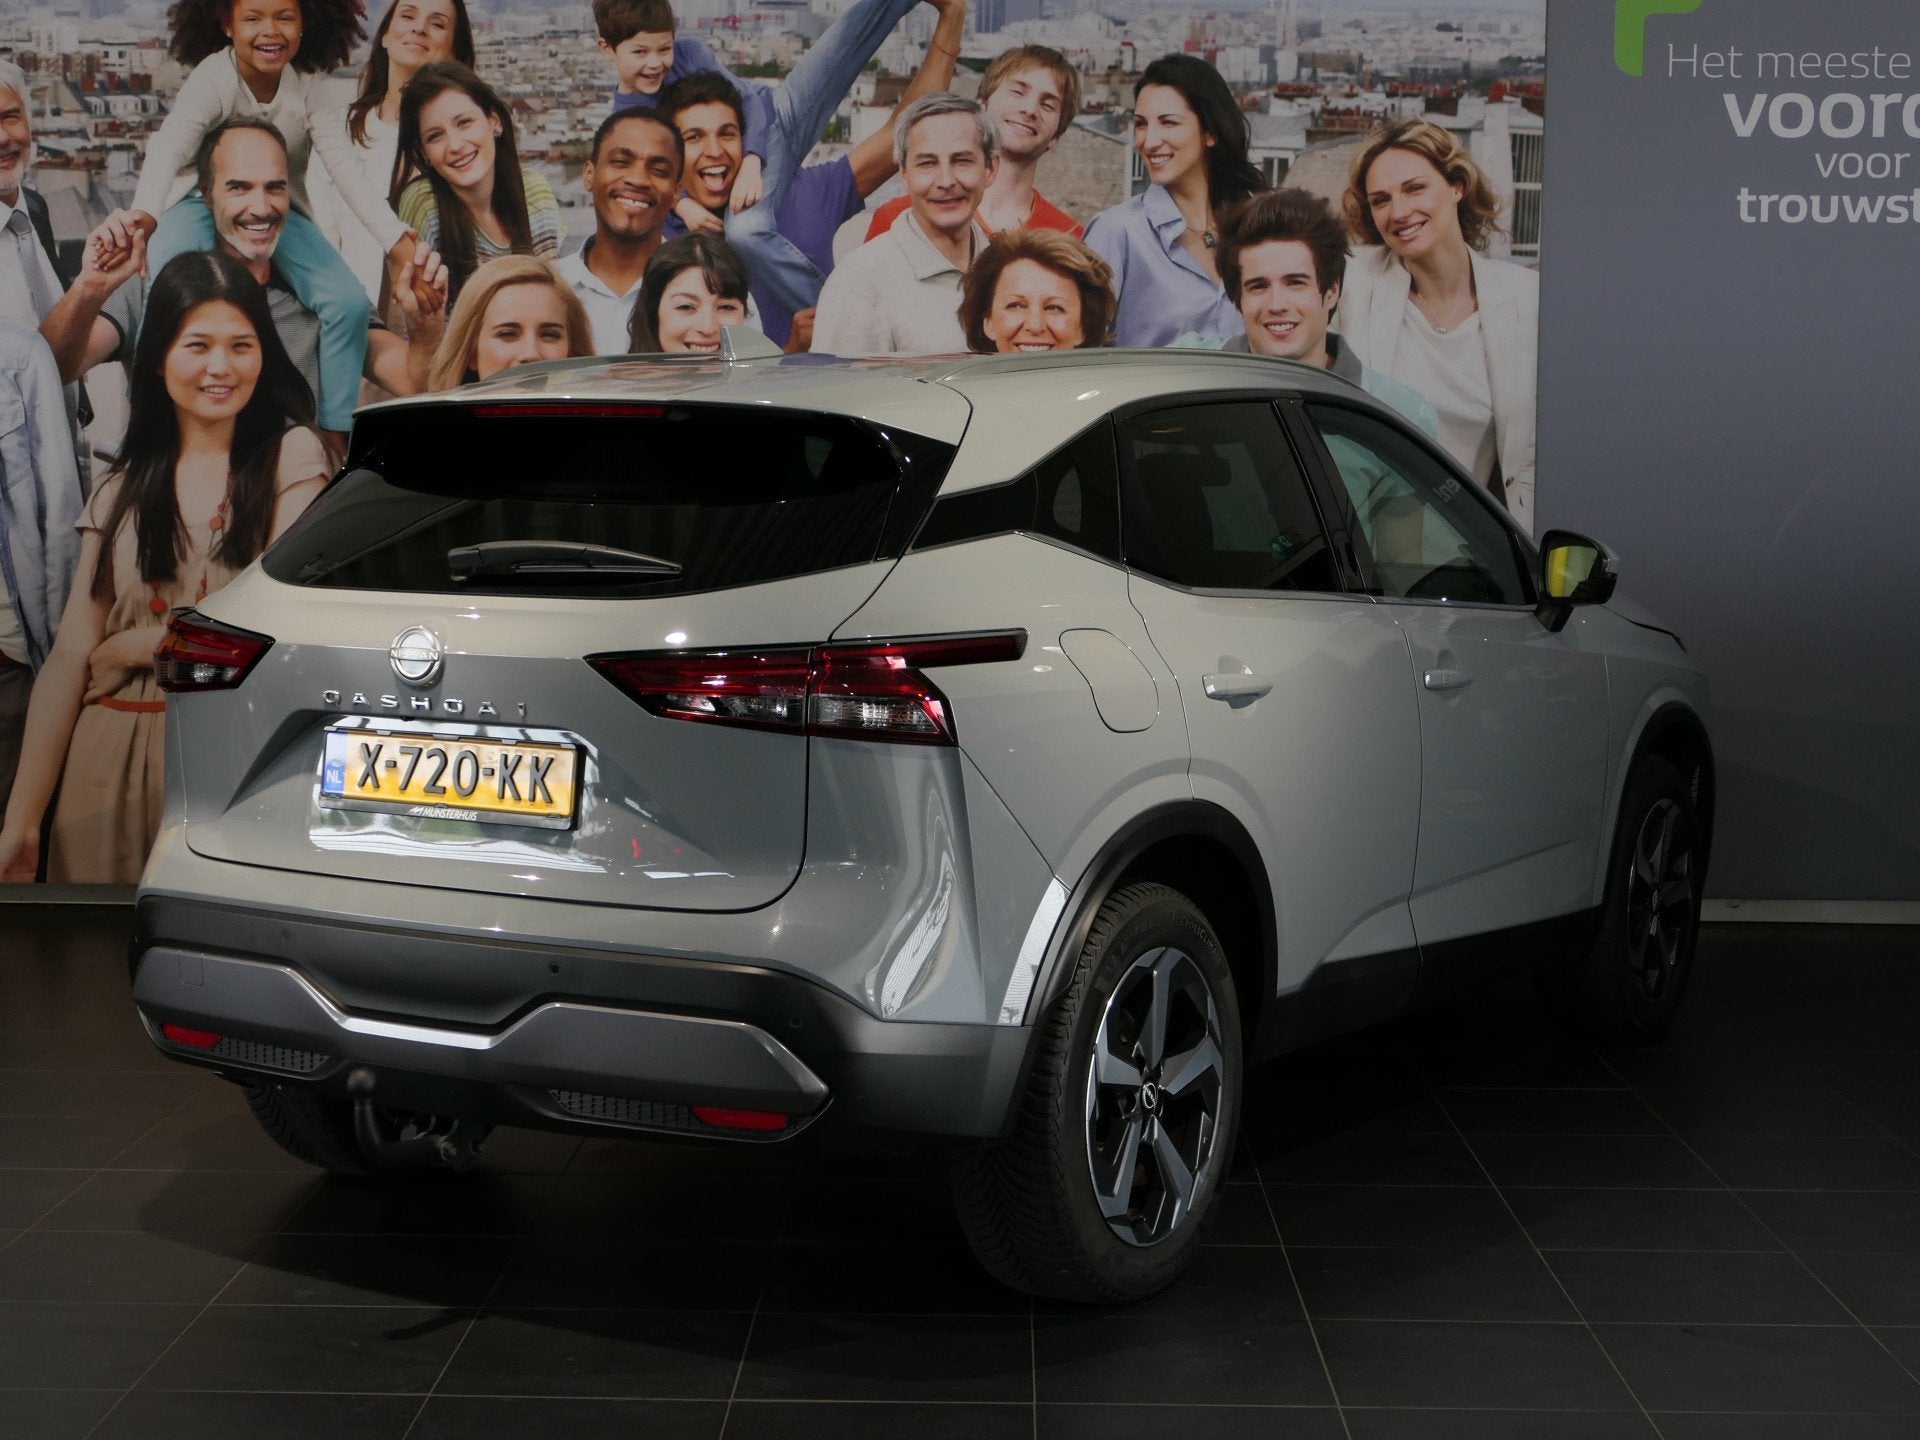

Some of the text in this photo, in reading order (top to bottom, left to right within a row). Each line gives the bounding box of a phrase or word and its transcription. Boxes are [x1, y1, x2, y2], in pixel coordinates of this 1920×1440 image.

[1668, 43, 1911, 79] Het meeste
[1815, 152, 1911, 179] voor
[390, 648, 439, 661] NISSAN
[322, 689, 527, 717] QASHQAI
[325, 768, 343, 784] NL
[357, 742, 554, 804] X-720-KK
[422, 807, 479, 821] MUNSTERHUIS
